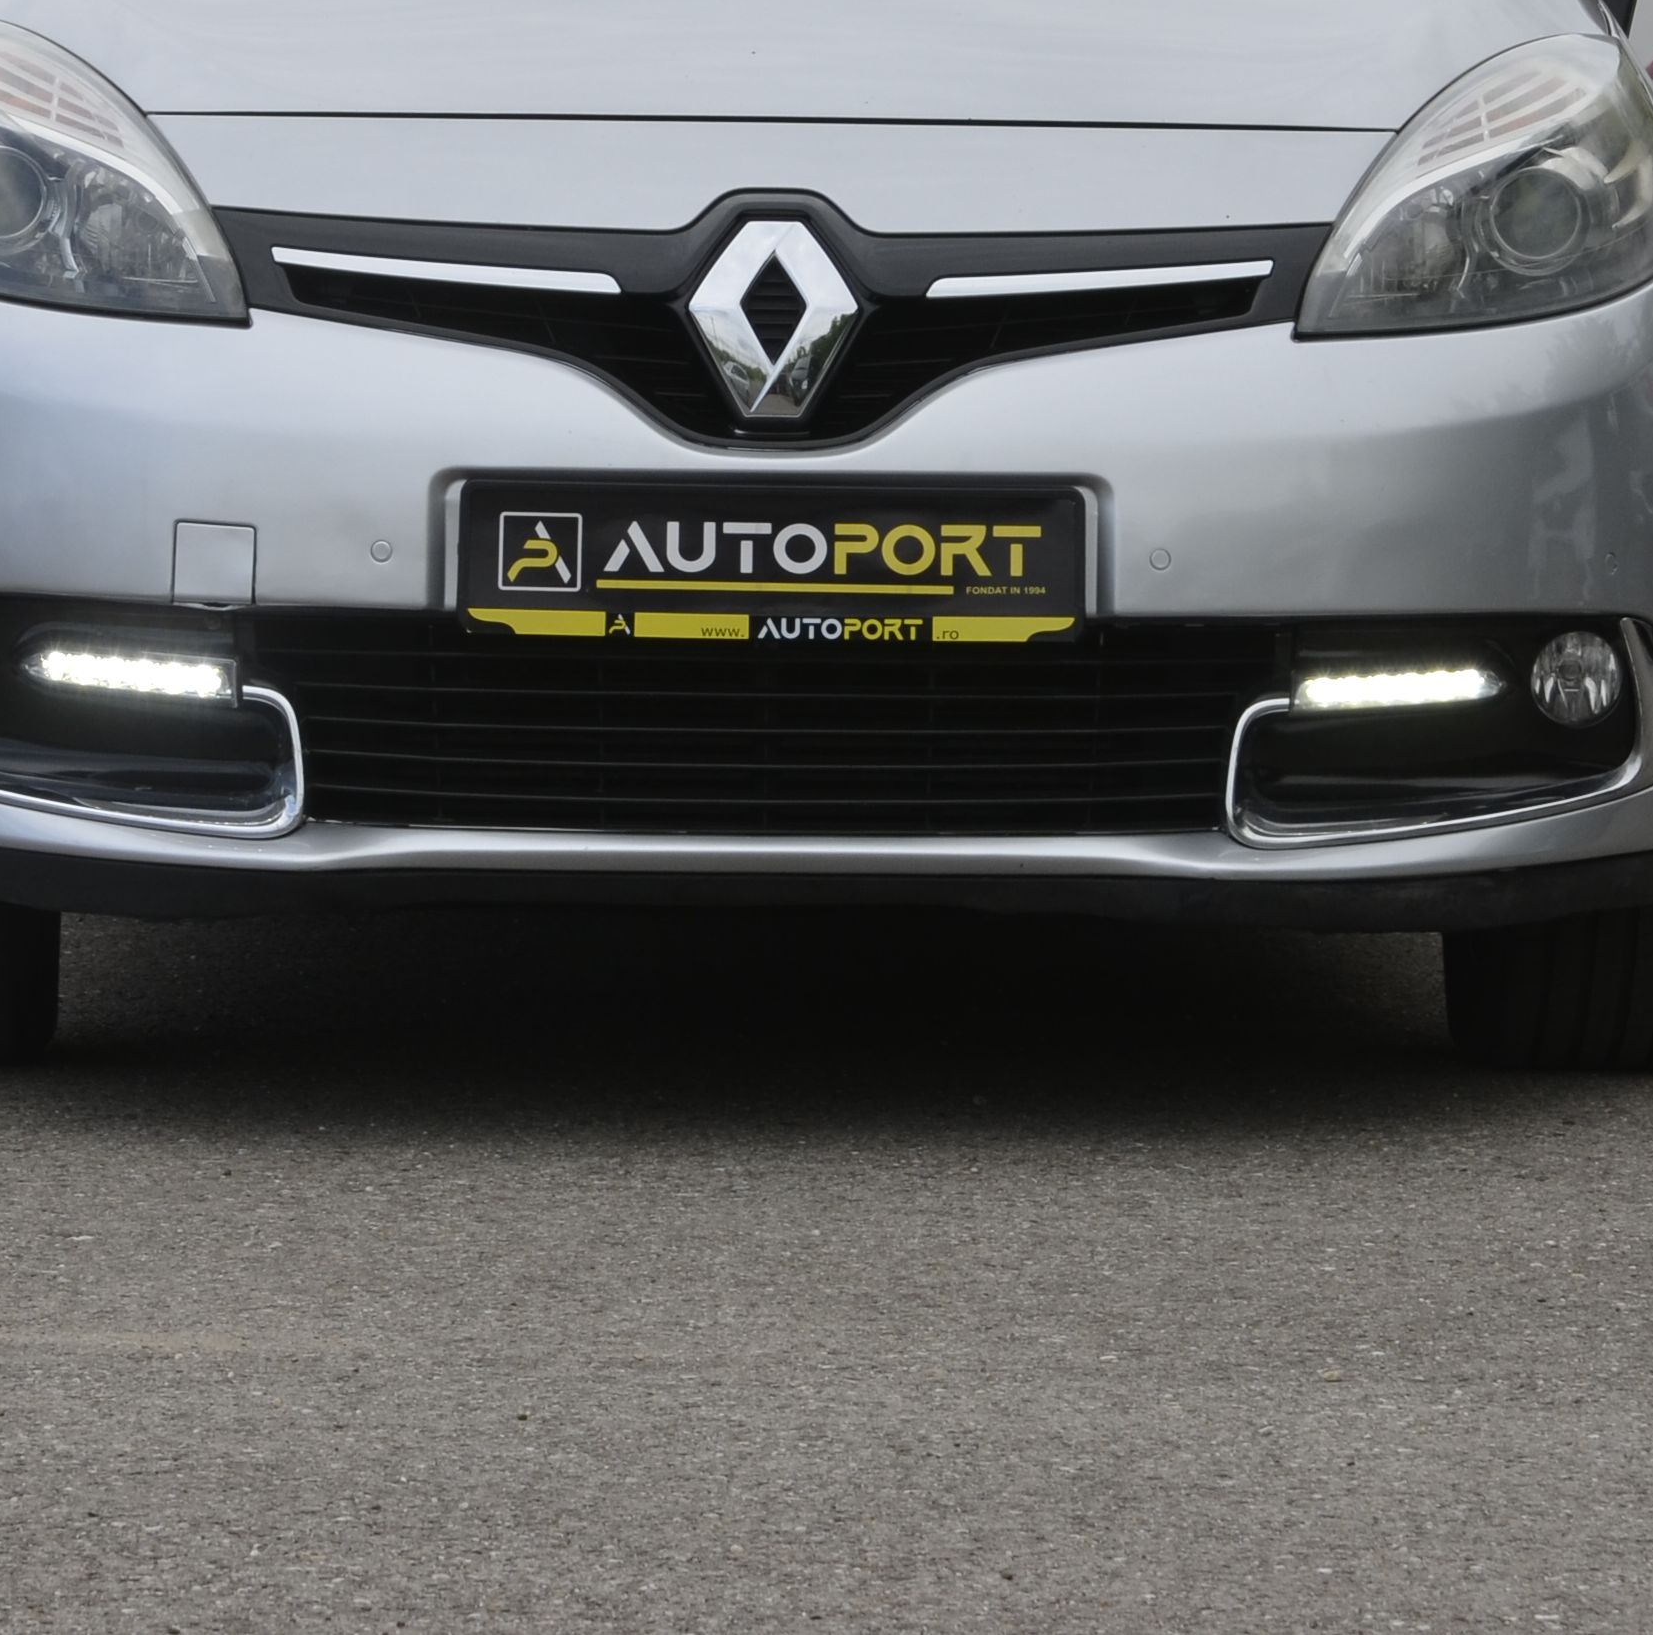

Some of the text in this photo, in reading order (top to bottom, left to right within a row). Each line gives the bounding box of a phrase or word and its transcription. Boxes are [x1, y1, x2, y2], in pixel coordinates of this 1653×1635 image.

[603, 520, 1042, 578] AUTOPORT
[965, 585, 1046, 596] FONDAT IN 1994
[701, 627, 745, 638] www.
[757, 617, 924, 641] AUTOPORT
